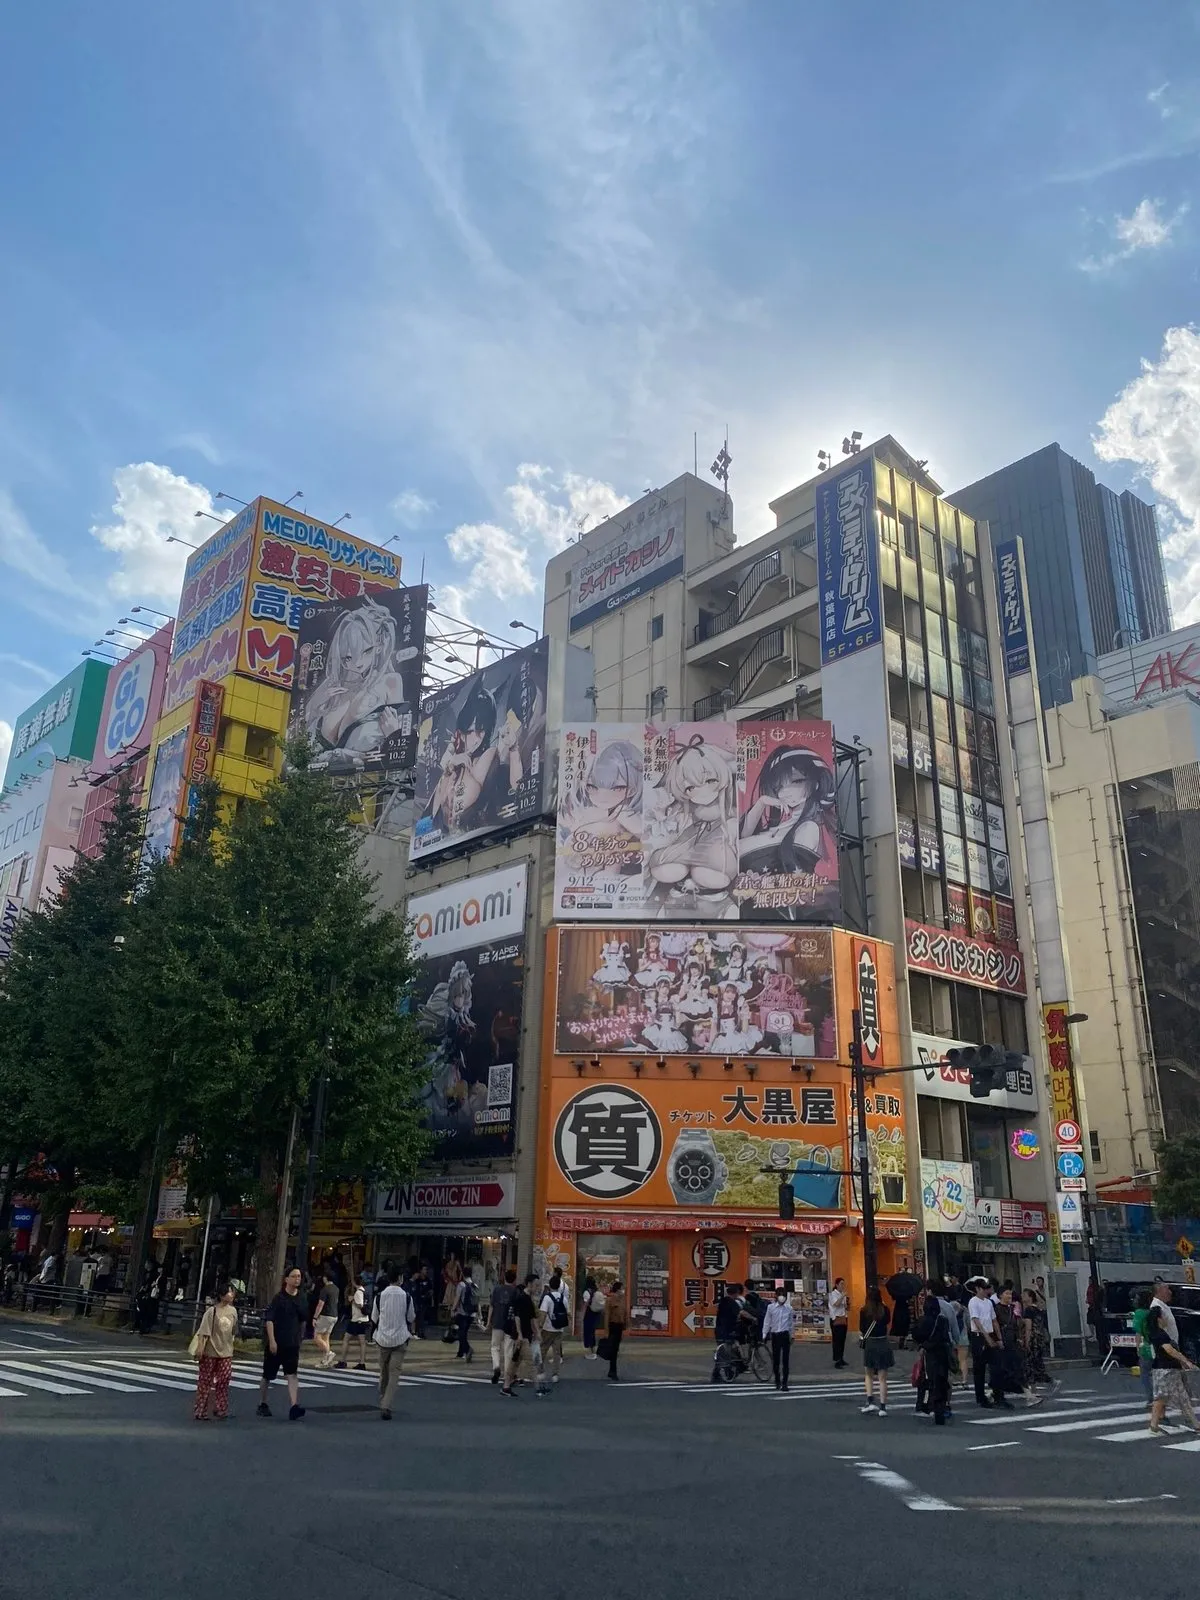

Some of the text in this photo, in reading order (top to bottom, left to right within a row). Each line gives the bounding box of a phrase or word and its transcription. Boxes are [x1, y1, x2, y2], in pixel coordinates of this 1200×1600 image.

[262, 510, 398, 579] MEDIAリサイクル
[576, 736, 590, 782] 伊404
[914, 750, 932, 772] 6F
[573, 831, 628, 853] 8年分の
[581, 851, 644, 868] ありがとう
[921, 847, 939, 870] 5F
[569, 876, 594, 887] 9/12
[416, 888, 512, 940] amiami
[910, 929, 1020, 987] メイドカジノ
[474, 1108, 510, 1123] amiami
[669, 1110, 716, 1124] チケット
[722, 1086, 838, 1126] 大黒屋
[565, 1101, 651, 1184] 質
[1061, 1126, 1075, 1138] 40
[1064, 1159, 1073, 1175] P
[416, 1187, 458, 1206] COMIC
[461, 1186, 480, 1205] ZIN
[946, 1180, 962, 1203] 22
